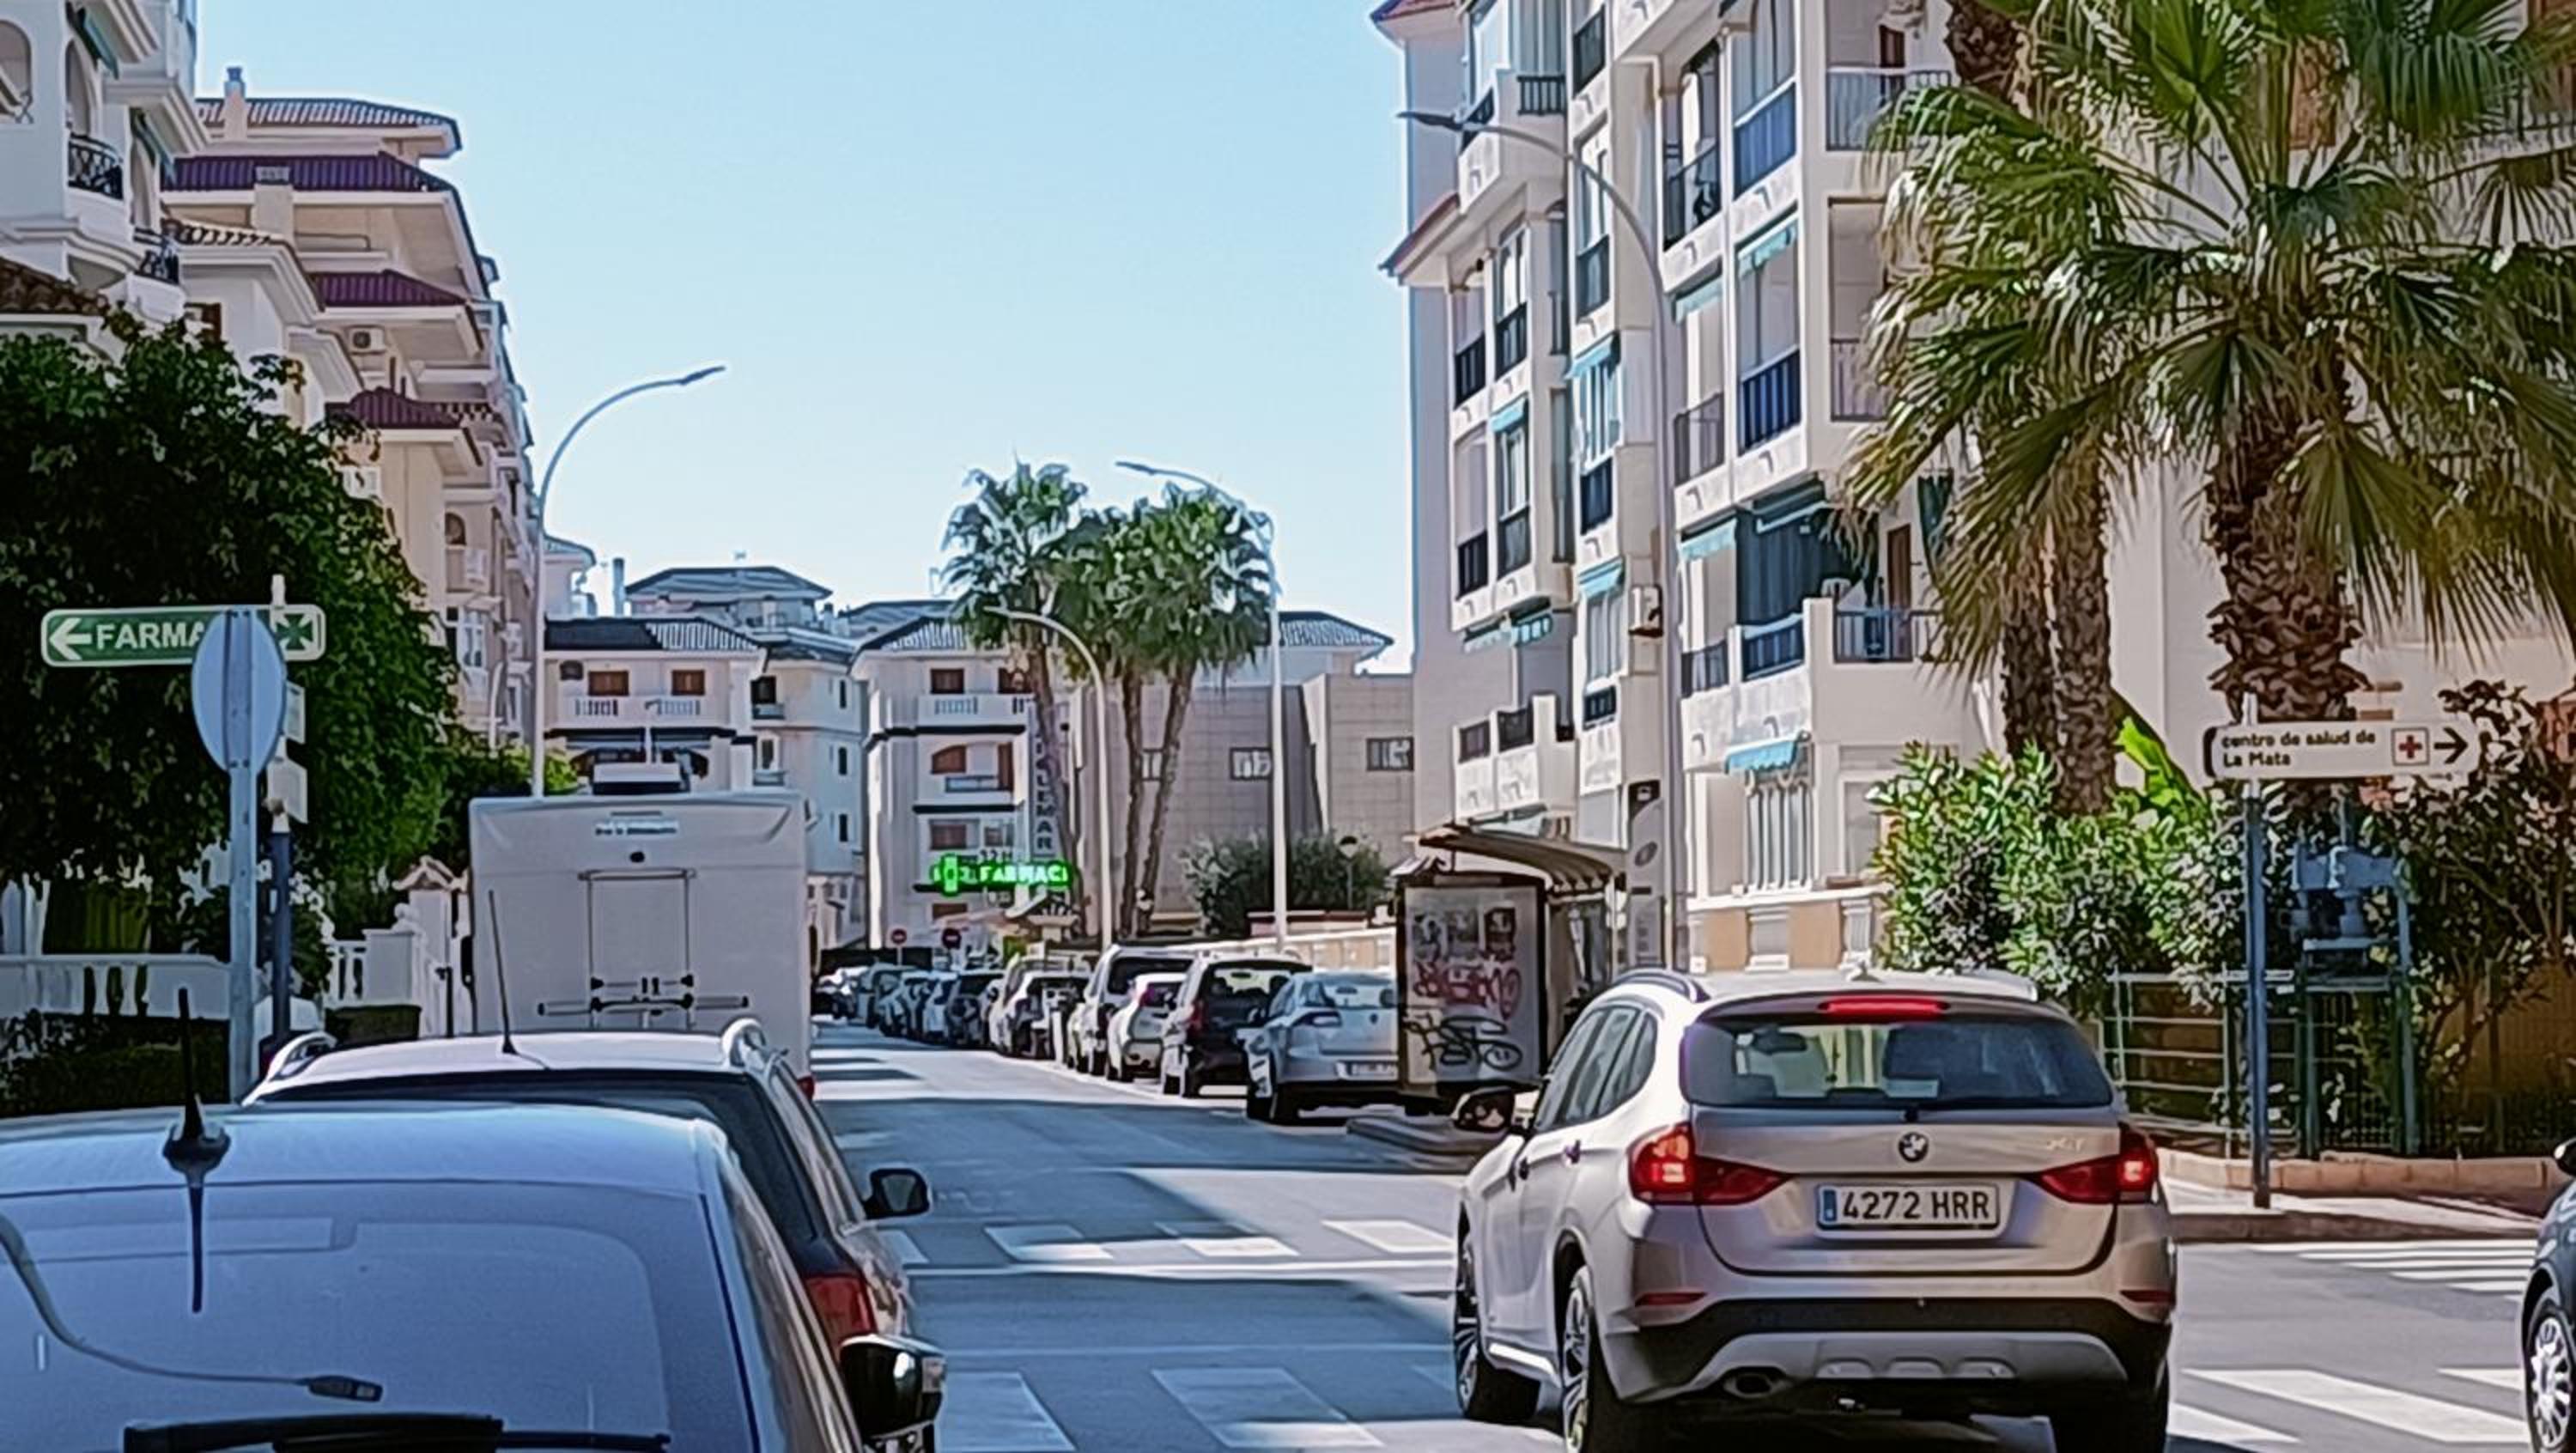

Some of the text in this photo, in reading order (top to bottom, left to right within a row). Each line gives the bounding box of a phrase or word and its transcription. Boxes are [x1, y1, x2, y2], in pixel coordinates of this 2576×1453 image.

[2221, 730, 2376, 748] centro de salud de
[2223, 751, 2291, 767] La Mata
[1843, 1191, 1989, 1219] 4272 HRR
